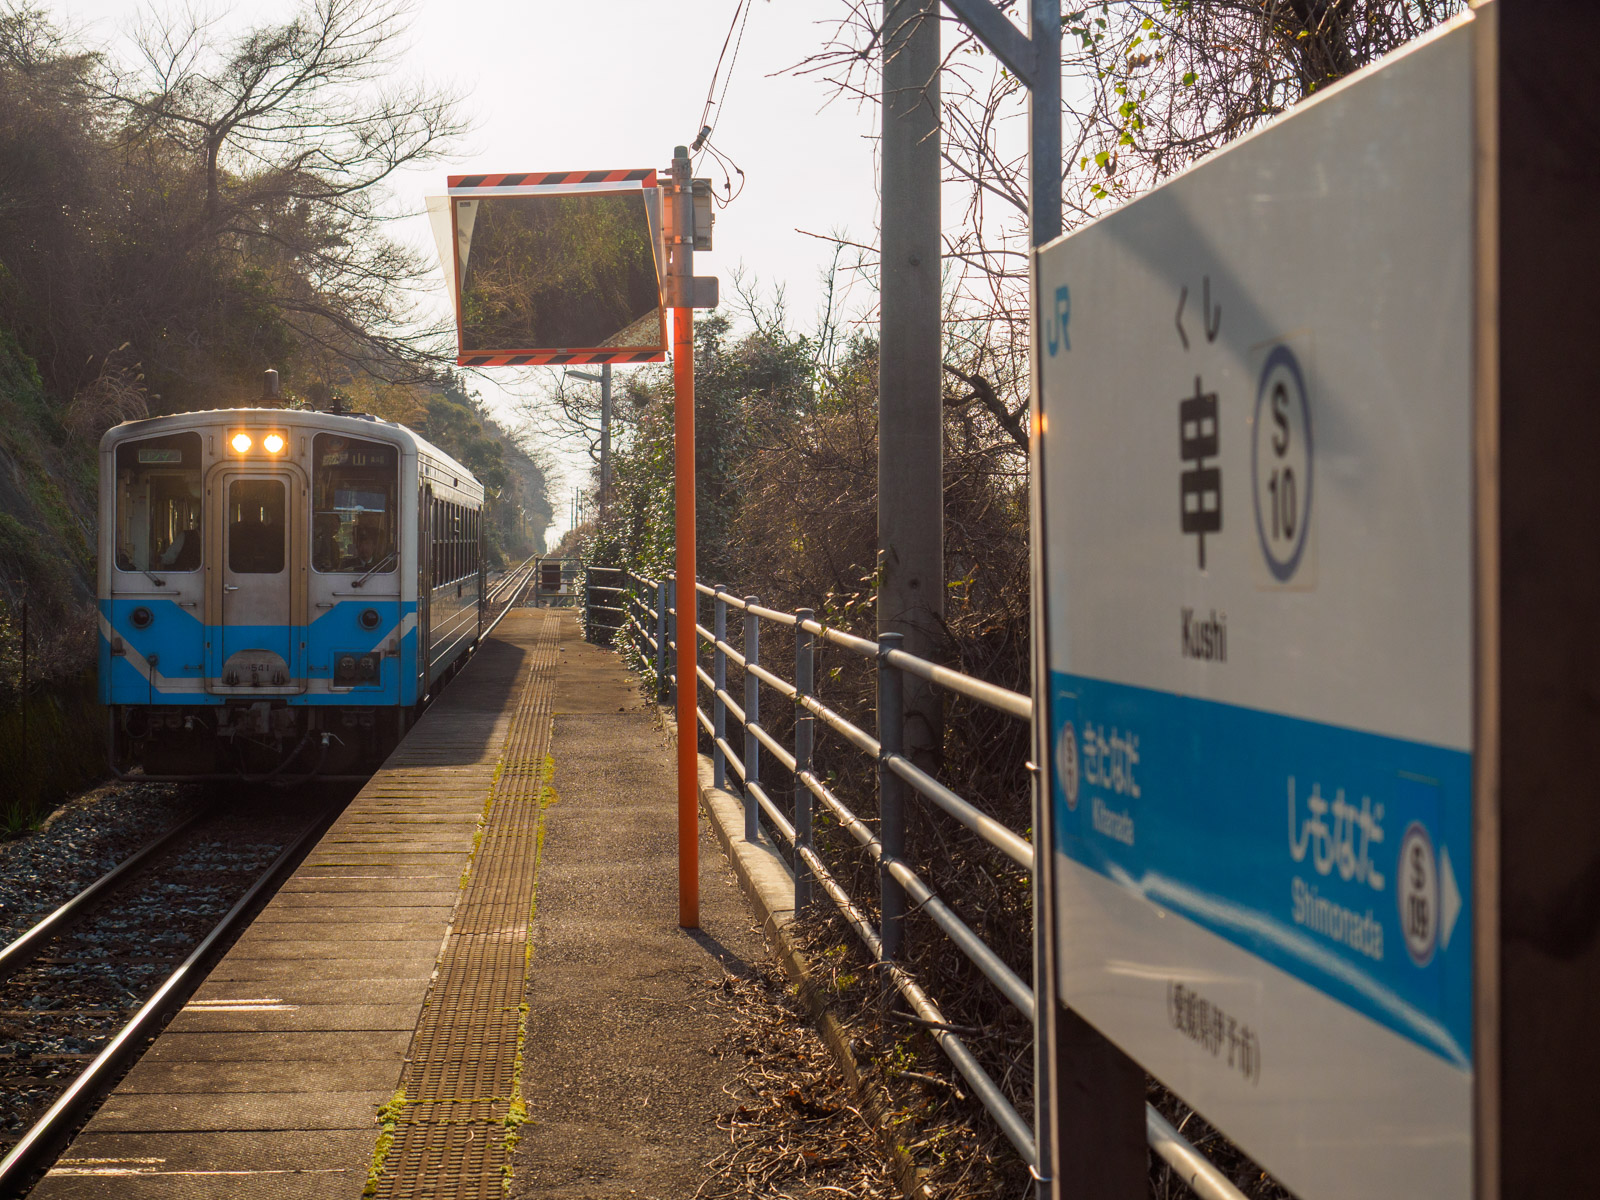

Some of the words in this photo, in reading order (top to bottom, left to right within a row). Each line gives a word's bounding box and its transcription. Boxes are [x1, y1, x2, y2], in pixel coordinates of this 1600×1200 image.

[1047, 285, 1071, 357] JR
[1175, 275, 1221, 353] くし
[1270, 381, 1290, 459] S
[1180, 375, 1222, 570] 串
[1267, 466, 1298, 542] 10
[1181, 607, 1229, 662] Kushi
[1082, 720, 1142, 799] きたなだ
[1287, 775, 1386, 891] しもなだ
[1291, 875, 1385, 961] Shimonada
